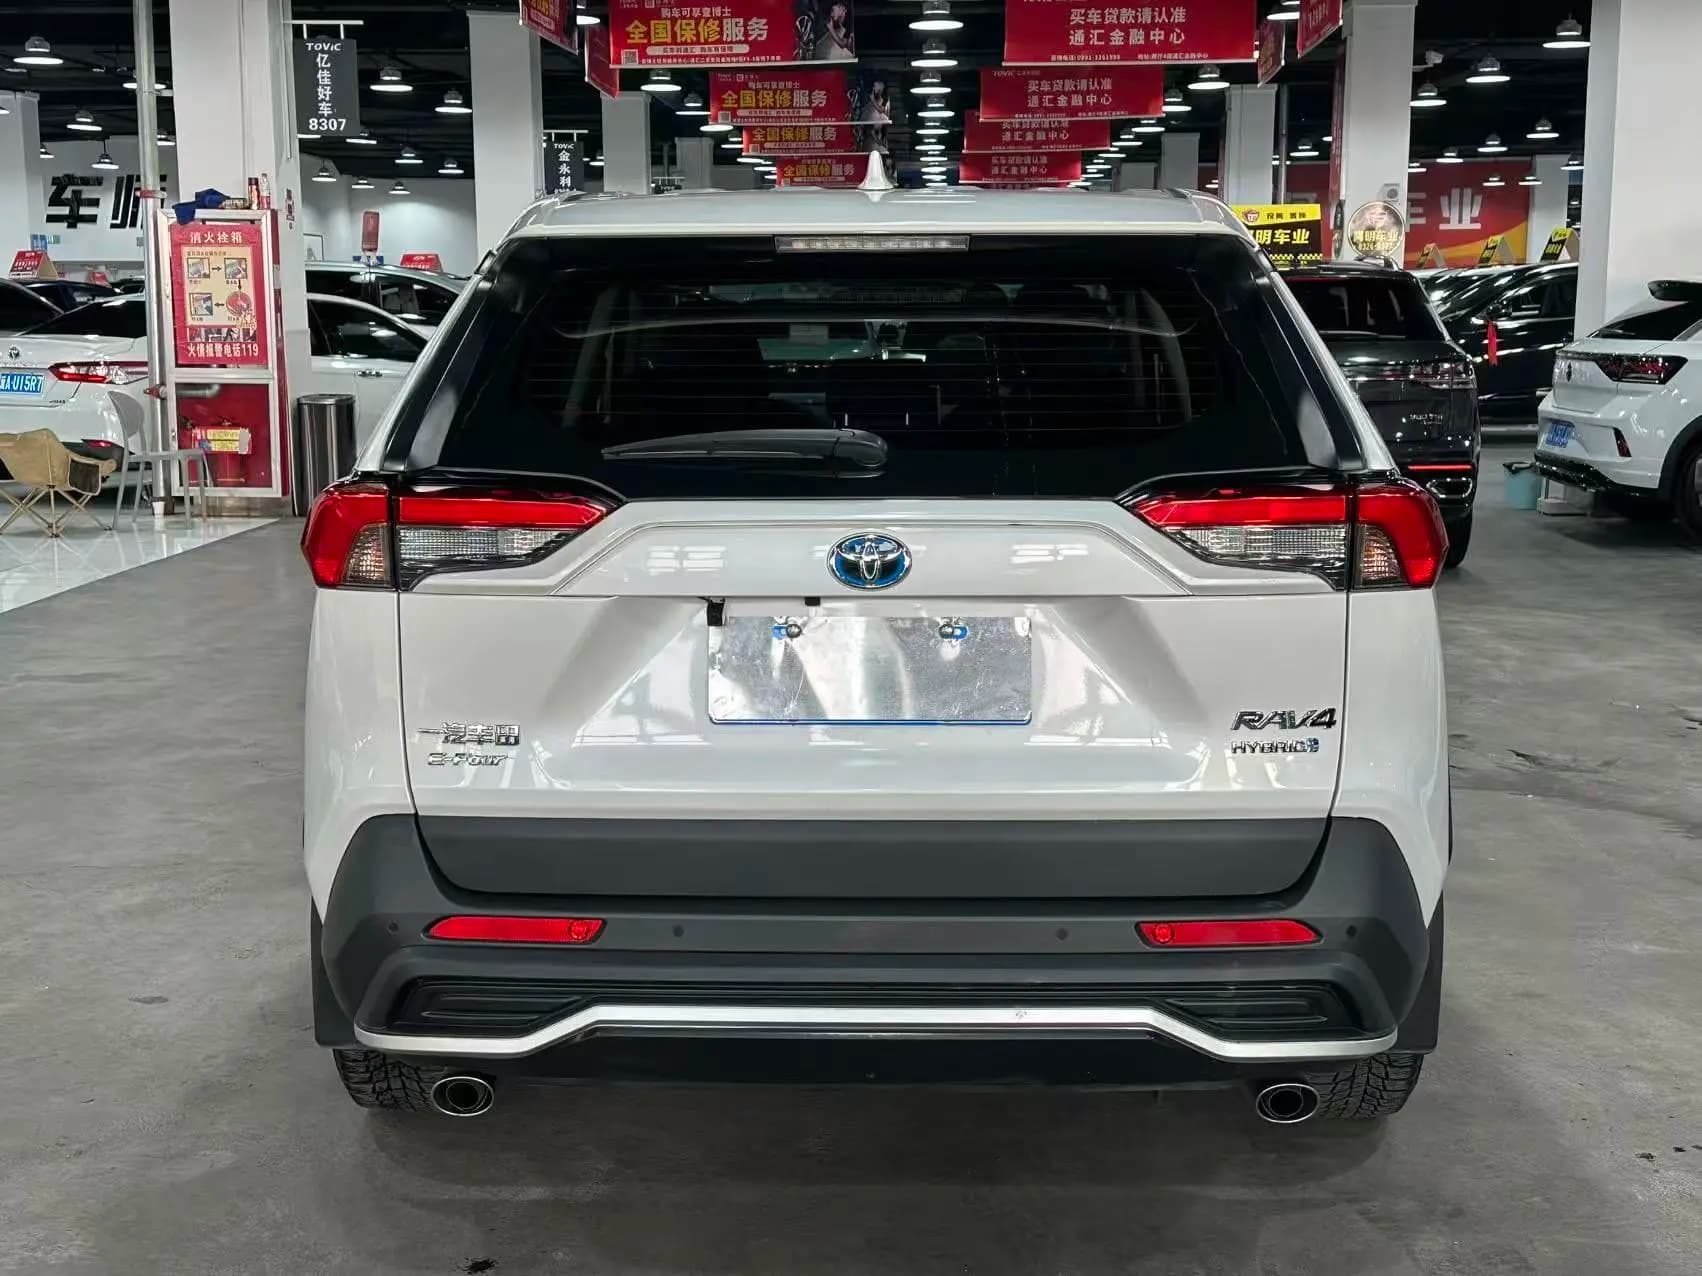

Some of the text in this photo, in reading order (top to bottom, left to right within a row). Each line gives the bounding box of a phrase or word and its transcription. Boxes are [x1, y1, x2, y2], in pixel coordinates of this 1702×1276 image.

[1070, 7, 1187, 24] 买车贷款请认准
[626, 17, 769, 44] 全国保修服务
[1069, 29, 1185, 46] 通汇金融中心
[316, 52, 332, 117] 亿佳好车
[1028, 78, 1112, 92] 买车贷款请认准
[722, 90, 827, 108] 全国保修服务
[1028, 95, 1112, 107] 通汇金融中心
[309, 118, 347, 131] 8307
[752, 127, 837, 141] 全国保修服务
[190, 231, 242, 243] 消火栓箱
[187, 343, 259, 357] 火情报警电话119
[1231, 708, 1337, 730] RAV4
[418, 722, 520, 745] 一汽丰田
[1231, 741, 1306, 753] HYBRID
[428, 753, 508, 766] E-Four
